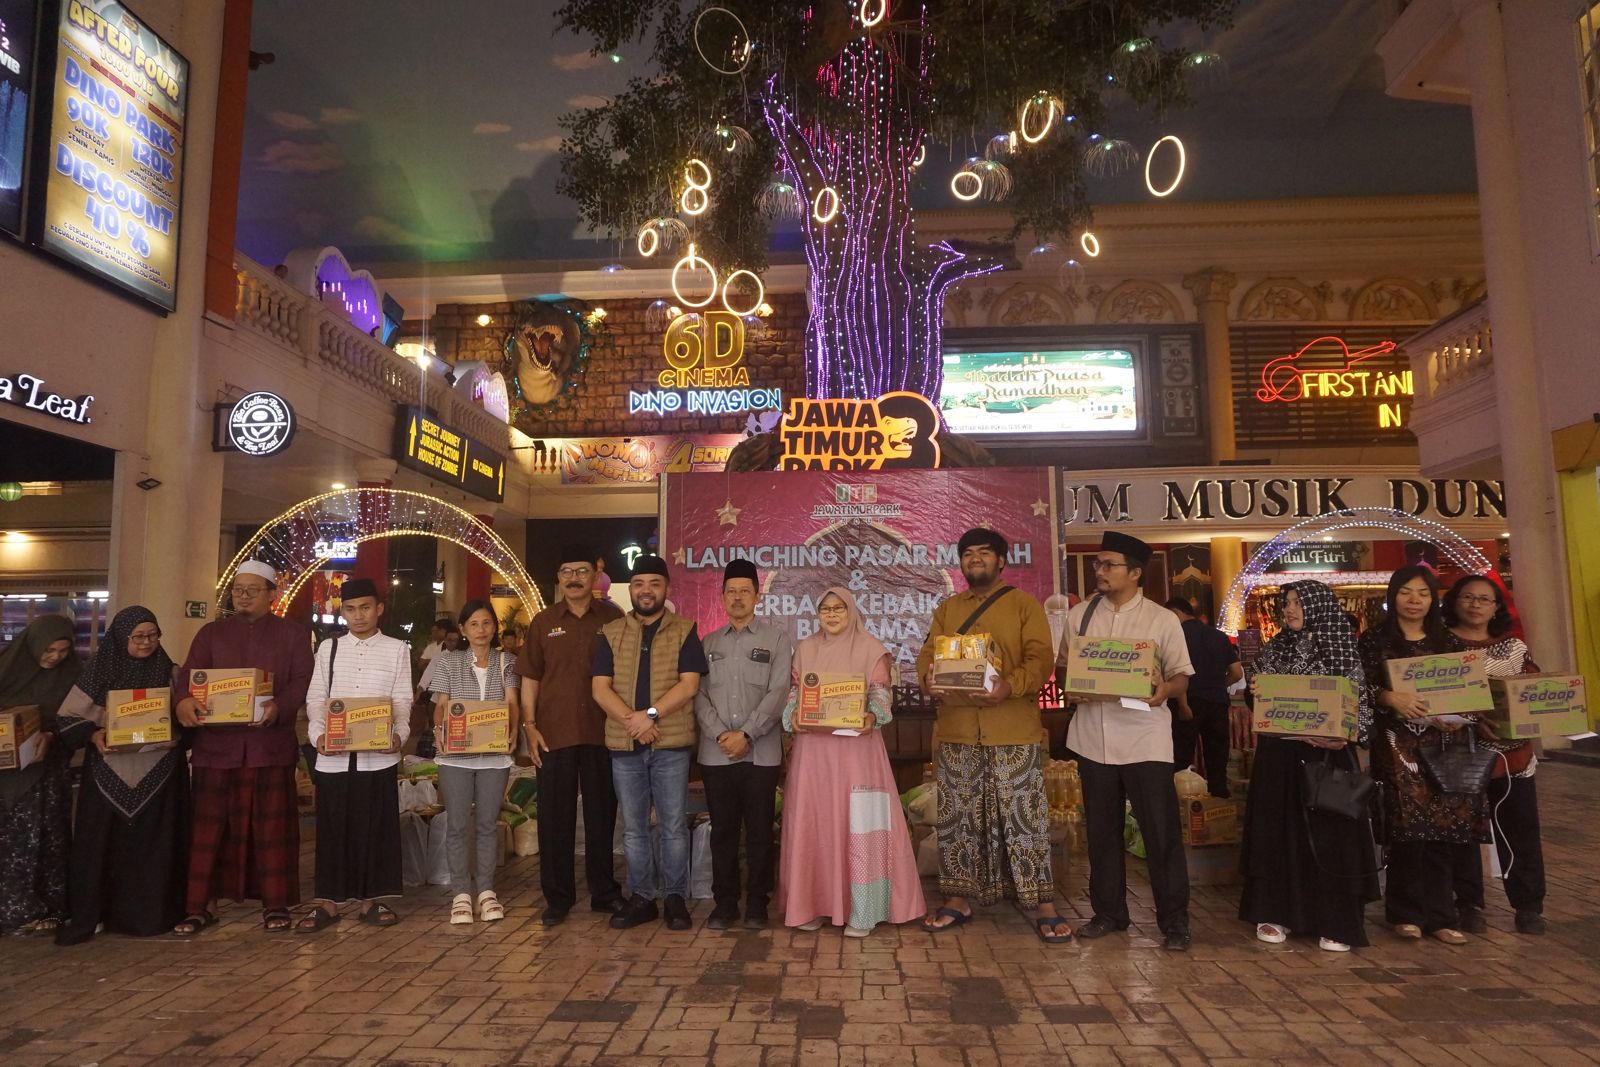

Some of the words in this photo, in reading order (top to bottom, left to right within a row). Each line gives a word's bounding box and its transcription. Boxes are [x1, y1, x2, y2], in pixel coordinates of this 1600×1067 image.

[68, 0, 133, 60] AFTER
[134, 45, 180, 103] FOUR
[64, 56, 121, 118] DINO
[124, 101, 175, 155] PARK
[66, 96, 110, 141] 90K
[67, 131, 88, 149] SENIN
[94, 145, 115, 166] KAMIS
[74, 125, 105, 149] WEEKDAY
[131, 136, 175, 182] 120K
[55, 142, 173, 236] DISCOUNT
[84, 194, 120, 240] 40
[664, 311, 745, 370] 6D
[658, 367, 750, 388] CINEMA
[1043, 368, 1104, 385] Puasa
[1302, 372, 1371, 398] FIRST
[629, 390, 682, 417] DINO
[687, 388, 782, 416] INVASION
[978, 383, 1089, 401] Ramadhan
[785, 401, 878, 428] JAWA
[784, 430, 885, 457] TIMUR
[1162, 478, 1356, 521] MUSIK
[686, 545, 838, 569] LAUNCHING
[844, 543, 930, 567] PASAR
[1309, 549, 1349, 565] Fitri
[848, 569, 869, 591] &
[1079, 648, 1141, 662] Sedaap
[1402, 665, 1471, 681] Sedaap
[211, 680, 251, 692] ENERGEN
[823, 684, 862, 695] ENERGEN
[1518, 689, 1576, 703] Sedaap
[120, 701, 162, 714] ENERGEN
[350, 708, 389, 720] ENERGEN
[469, 711, 506, 723] ENERGEN
[1264, 708, 1329, 723] Sedaap
